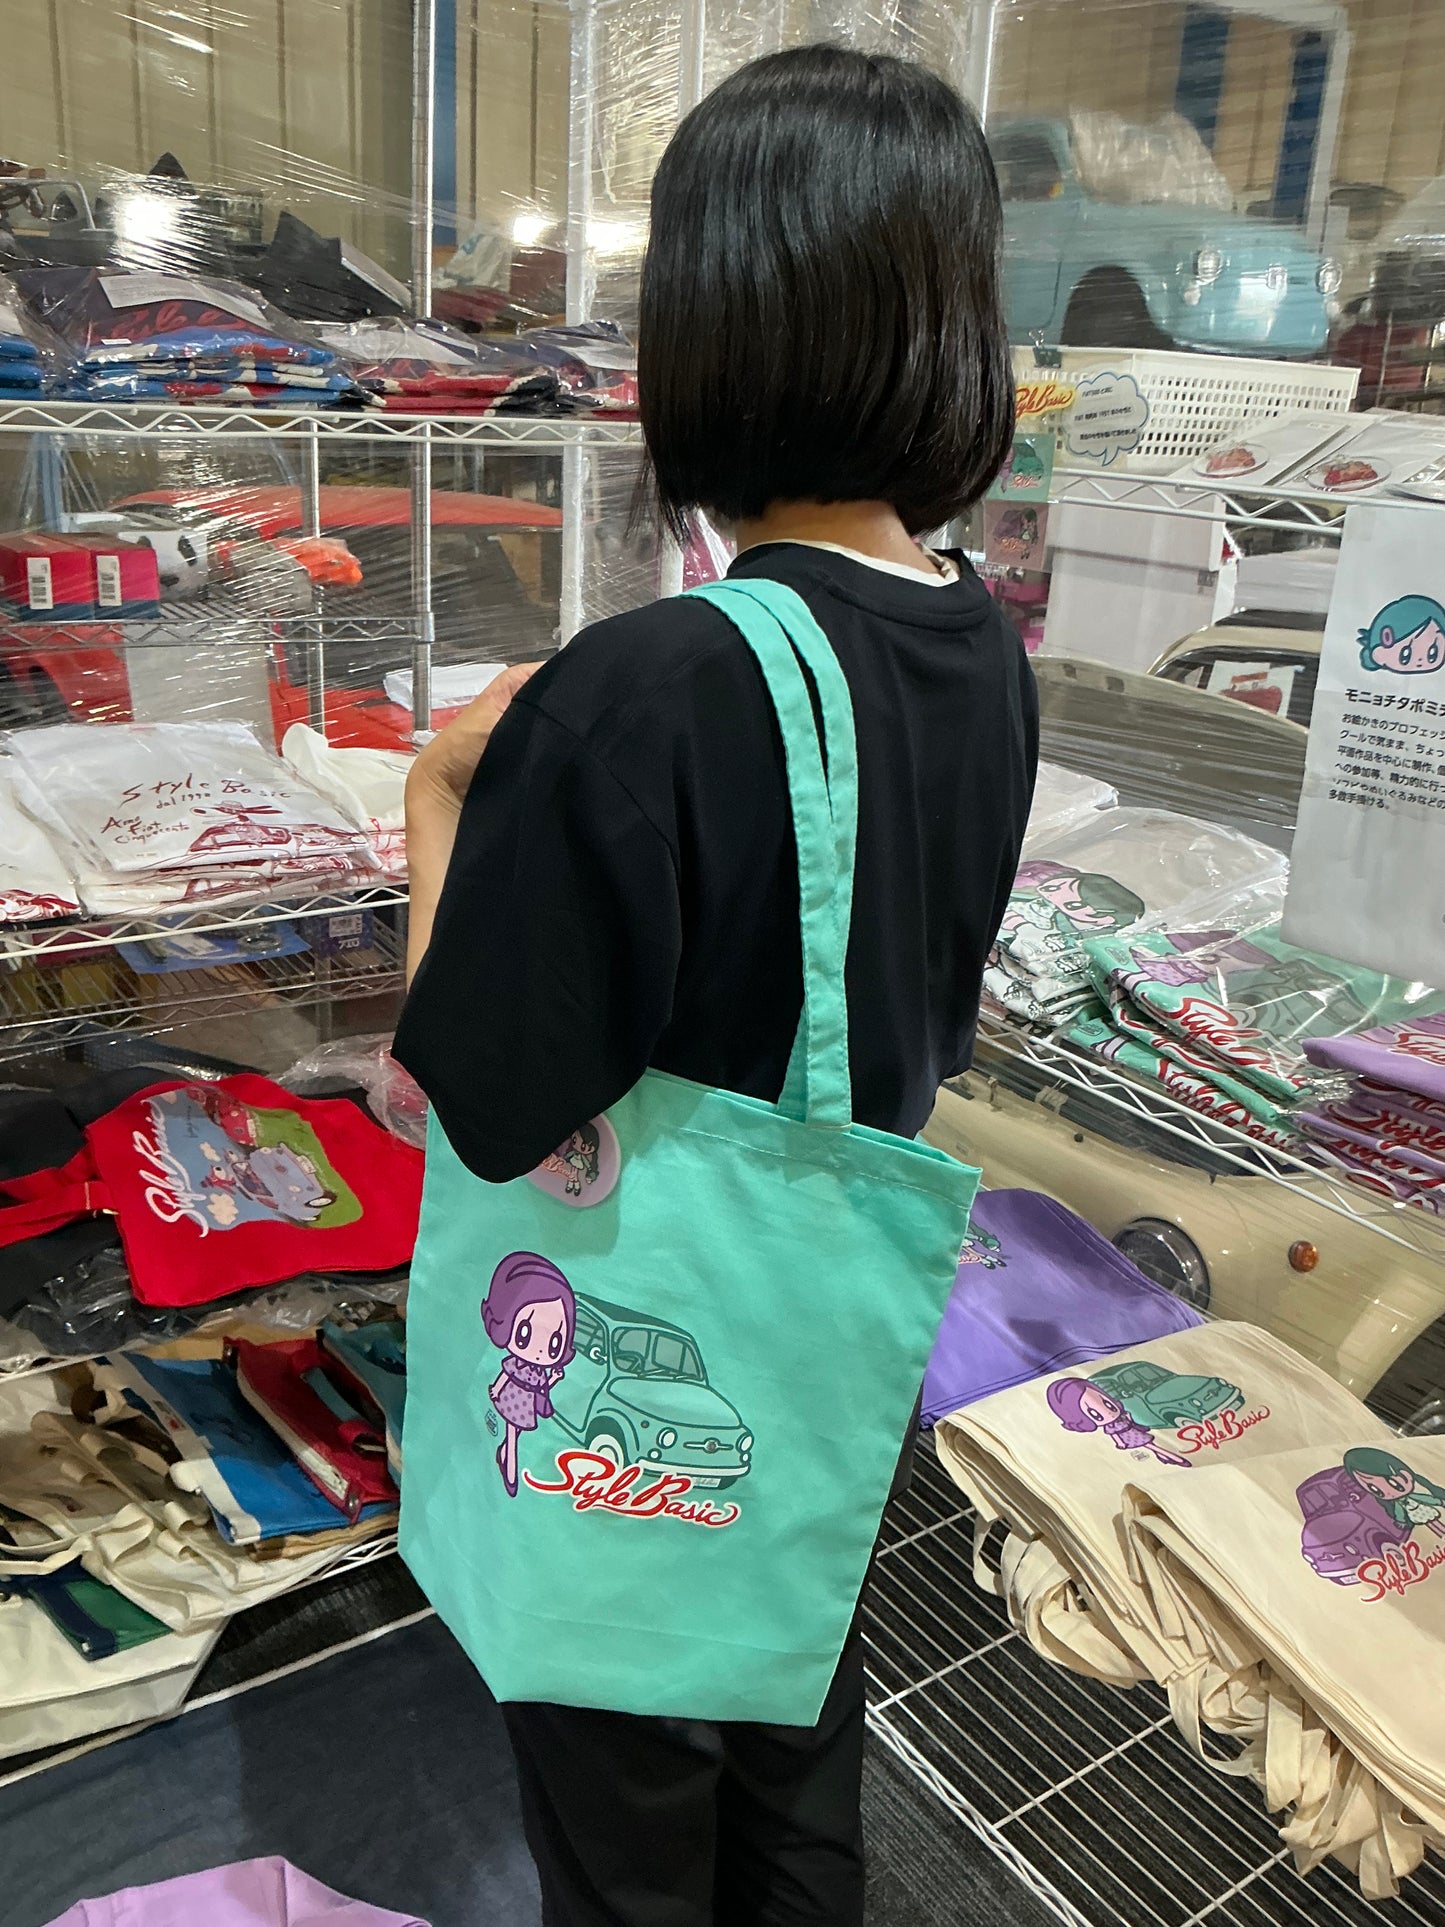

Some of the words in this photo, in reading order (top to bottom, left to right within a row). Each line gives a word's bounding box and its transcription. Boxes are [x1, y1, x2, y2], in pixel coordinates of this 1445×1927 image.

[118, 773, 210, 808] Style
[221, 779, 291, 798] Basic
[128, 820, 161, 836] Fiat
[139, 1170, 209, 1238] Style
[1177, 1419, 1227, 1454] Style
[1219, 1405, 1271, 1443] Basic
[524, 1451, 641, 1511] Style
[603, 1473, 738, 1526] Basic
[1357, 1552, 1412, 1602] Style
[1402, 1541, 1445, 1588] Basi
